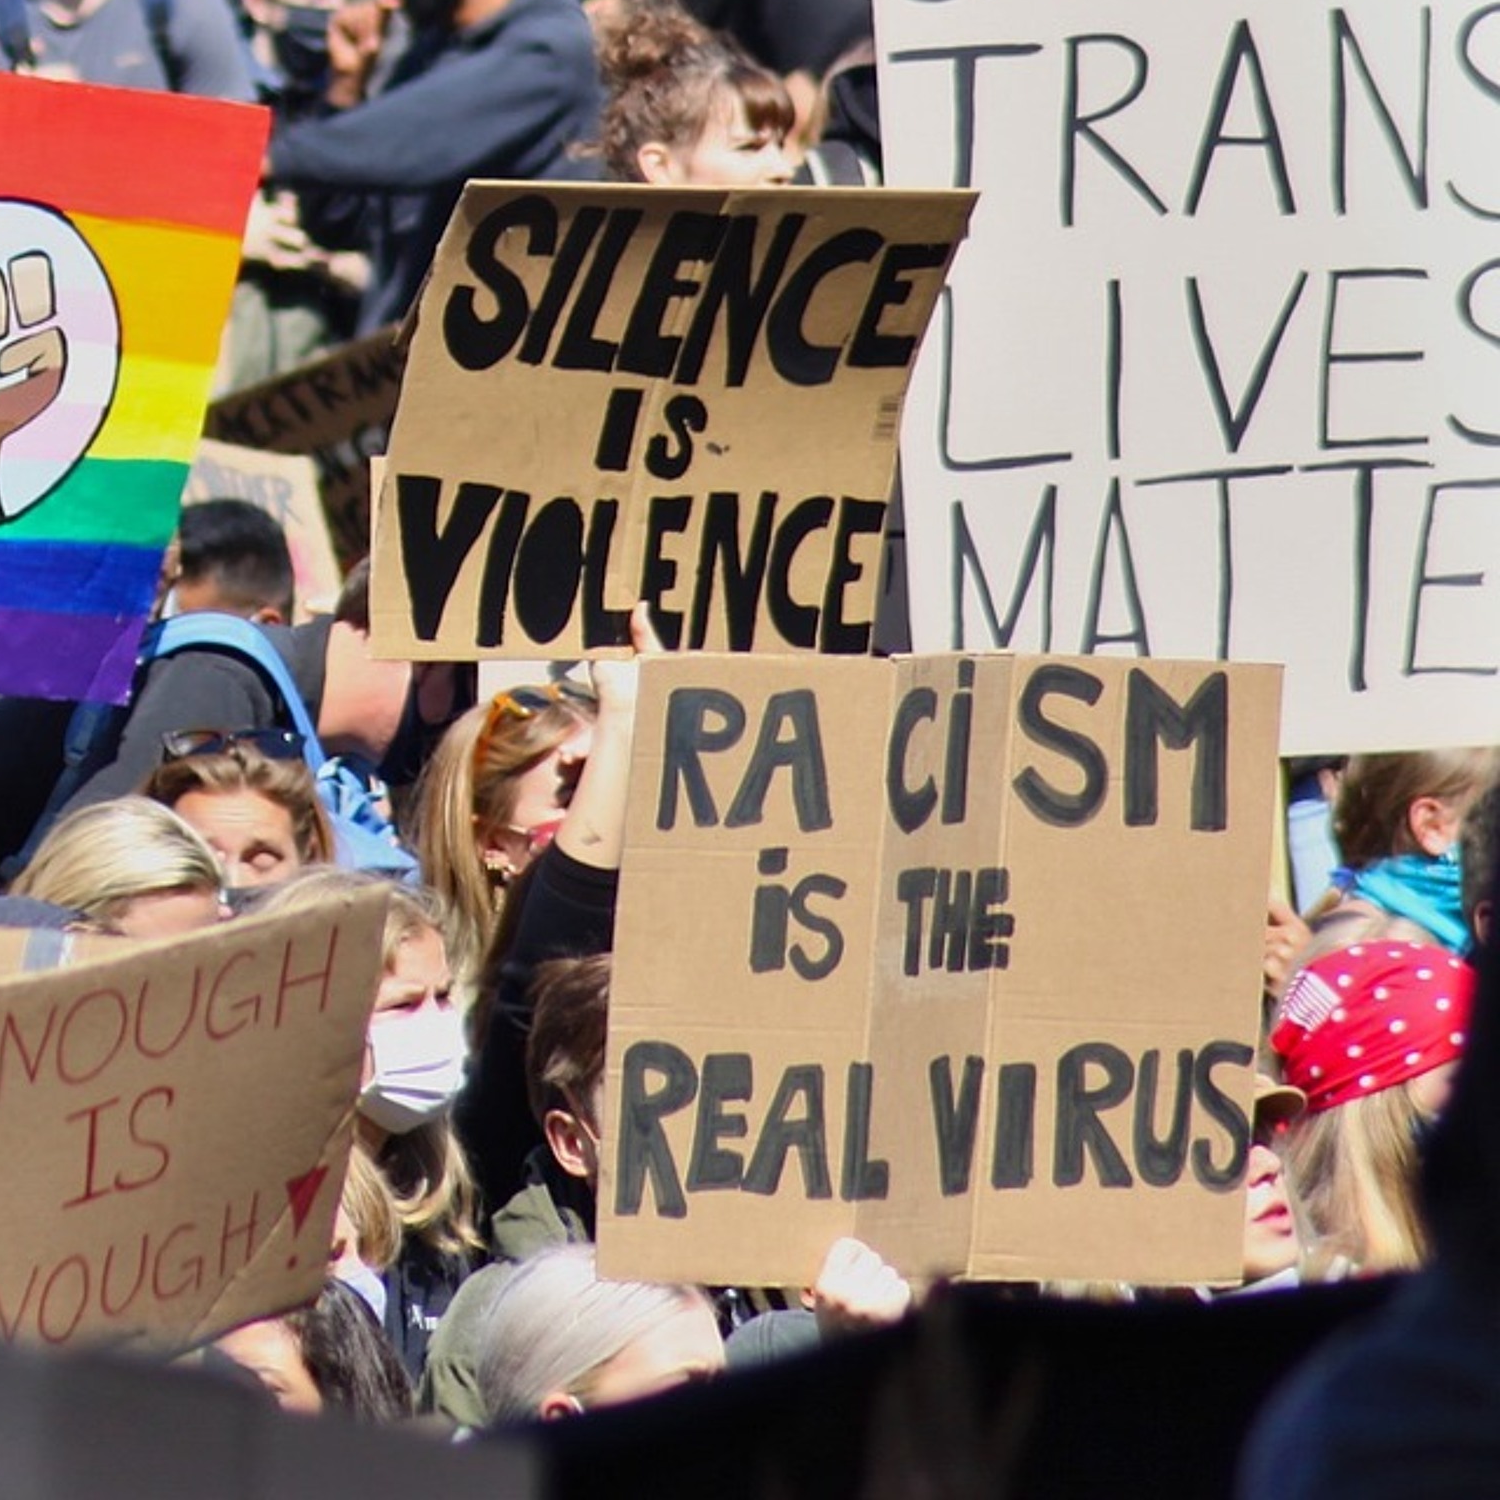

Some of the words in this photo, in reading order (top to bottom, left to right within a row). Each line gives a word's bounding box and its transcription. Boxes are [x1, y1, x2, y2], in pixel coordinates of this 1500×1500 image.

[442, 194, 952, 388] SILENCE
[594, 387, 708, 481] IS
[395, 473, 887, 654] VIOLENCE
[897, 866, 1016, 977] THE
[63, 1086, 176, 1210] IS
[614, 1040, 890, 1219] REAL
[928, 1040, 1255, 1197] VIRUS
